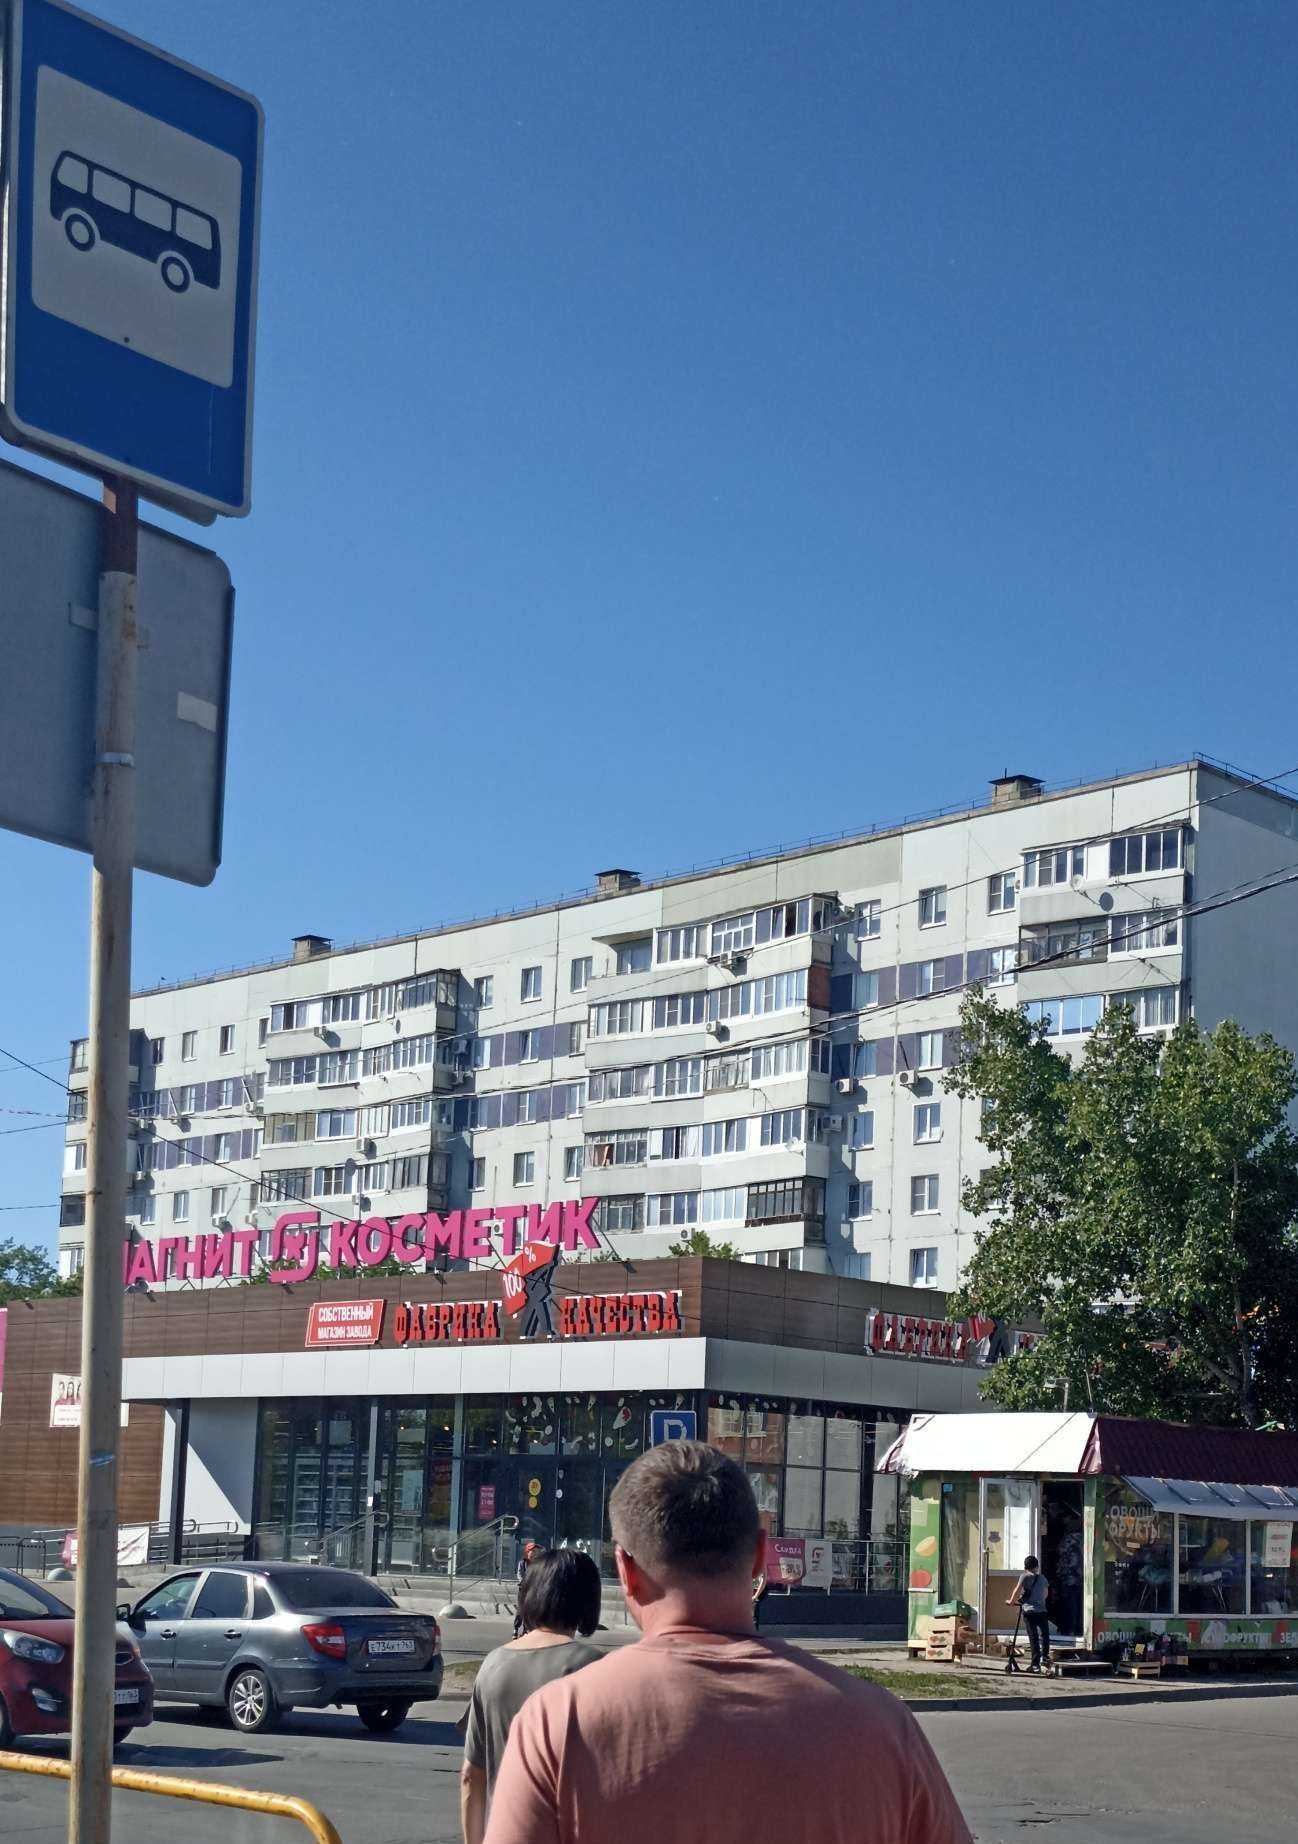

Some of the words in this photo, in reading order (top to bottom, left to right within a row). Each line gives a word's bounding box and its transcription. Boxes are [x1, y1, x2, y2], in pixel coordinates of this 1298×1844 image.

[328, 1196, 602, 1270] КОСМЕТИК
[317, 1302, 374, 1323] СОБСТВЕННЫЙ
[393, 1302, 500, 1345] ФАБРИКА
[502, 1267, 522, 1299] 100
[559, 1291, 682, 1336] КАЧЕСТВА
[316, 1326, 345, 1340] МАГАЗИН
[345, 1325, 372, 1338] ЗАВОДА
